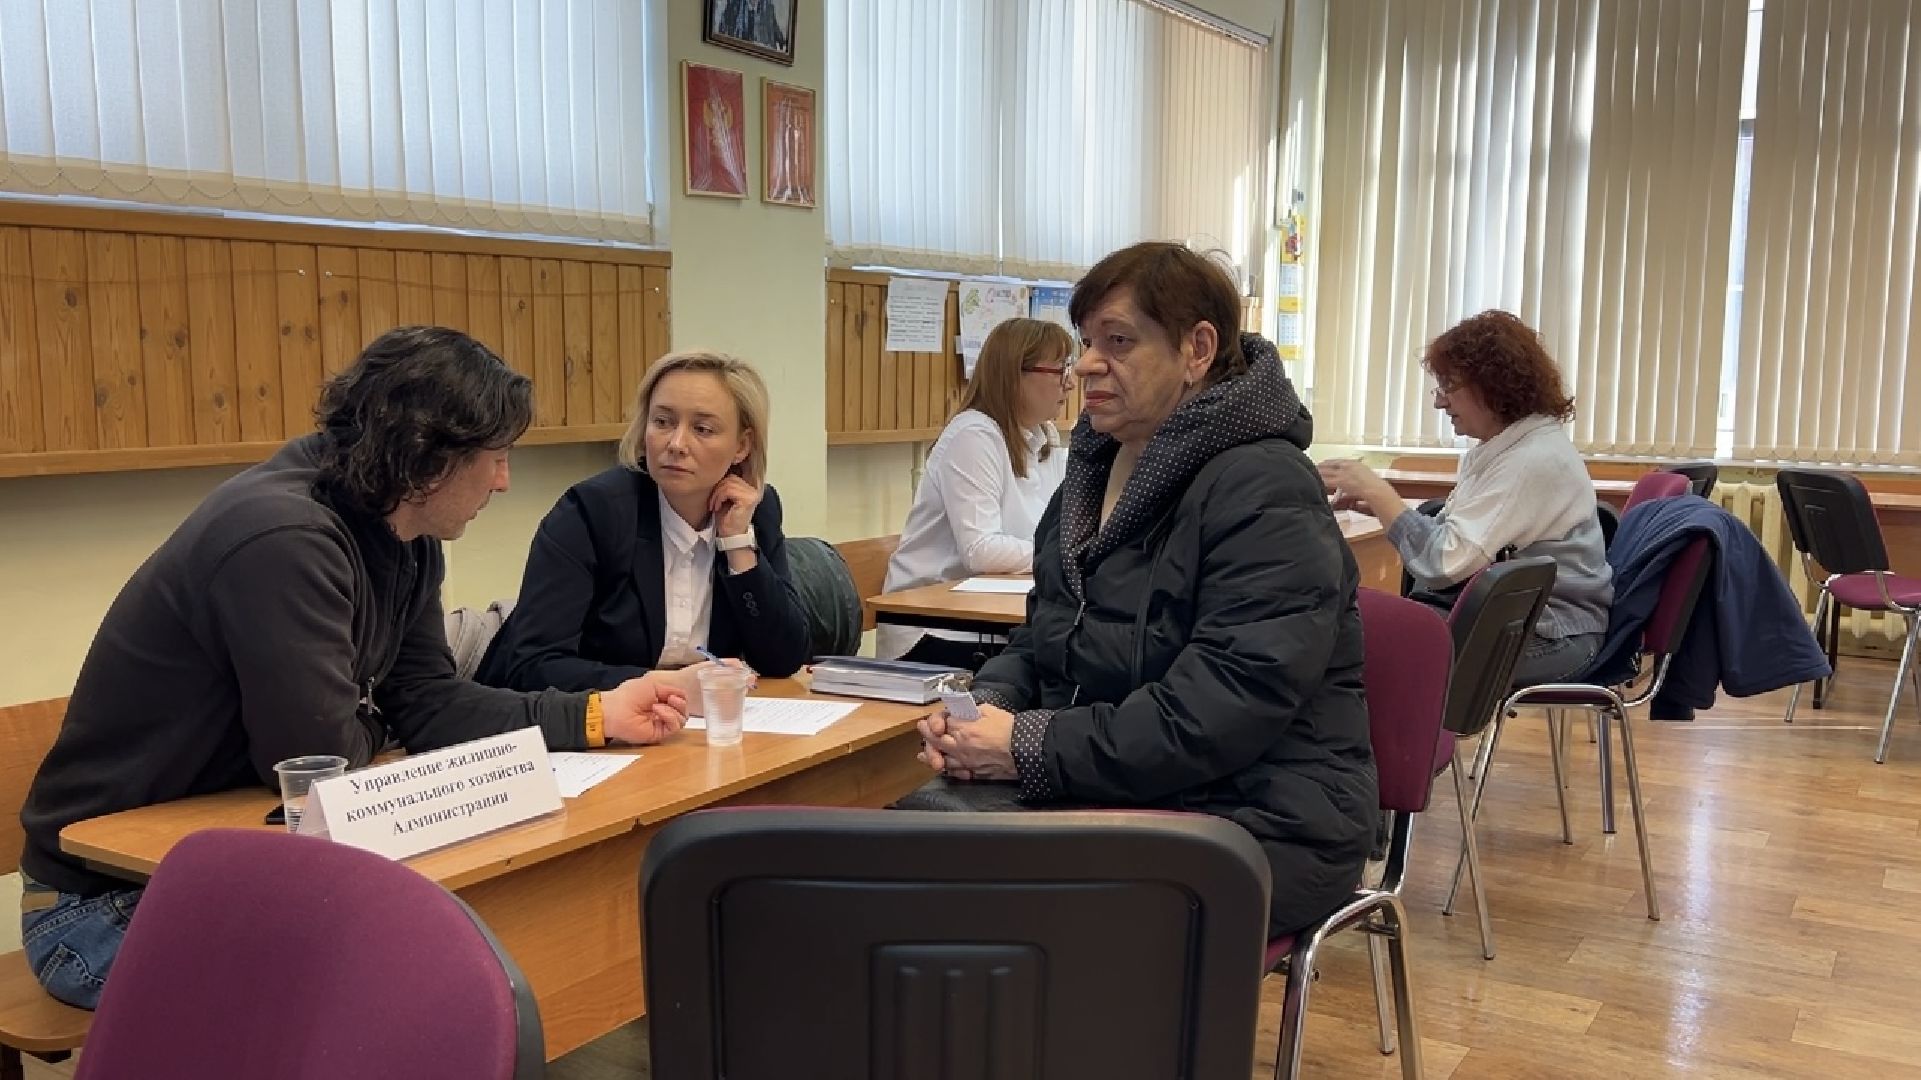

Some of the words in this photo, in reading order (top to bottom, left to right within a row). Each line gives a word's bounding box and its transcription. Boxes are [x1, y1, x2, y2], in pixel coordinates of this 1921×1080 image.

[346, 780, 465, 822] коммунального
[468, 761, 535, 788] хозяйства
[350, 760, 443, 794] Управление
[393, 792, 509, 835] Администрации
